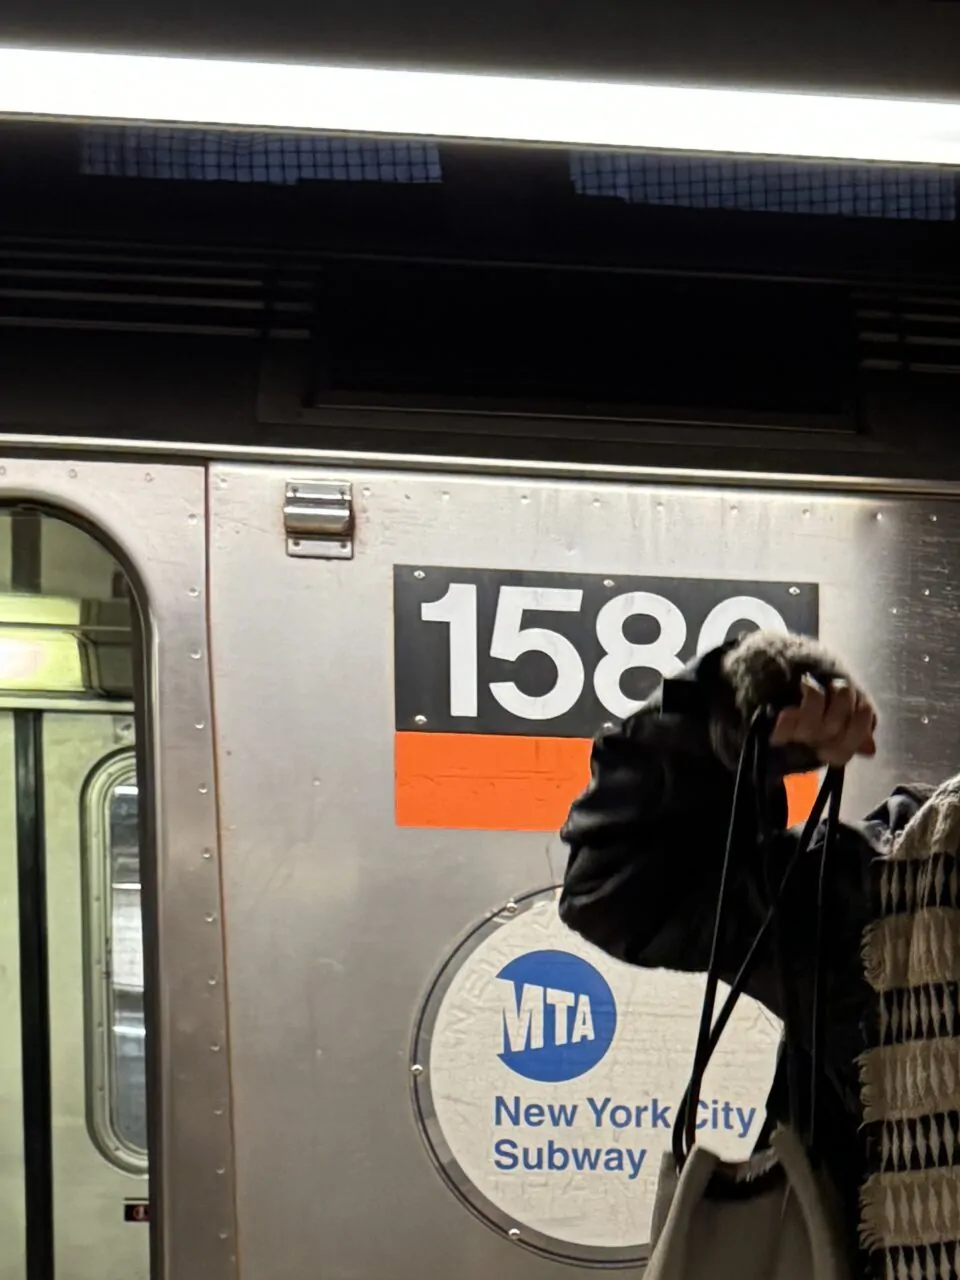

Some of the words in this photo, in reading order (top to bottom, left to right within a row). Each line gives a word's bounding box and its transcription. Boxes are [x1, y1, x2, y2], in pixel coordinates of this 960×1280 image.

[495, 976, 595, 1055] MTA
[493, 1096, 578, 1128] New
[586, 1097, 671, 1129] York
[493, 1138, 647, 1180] Subway
